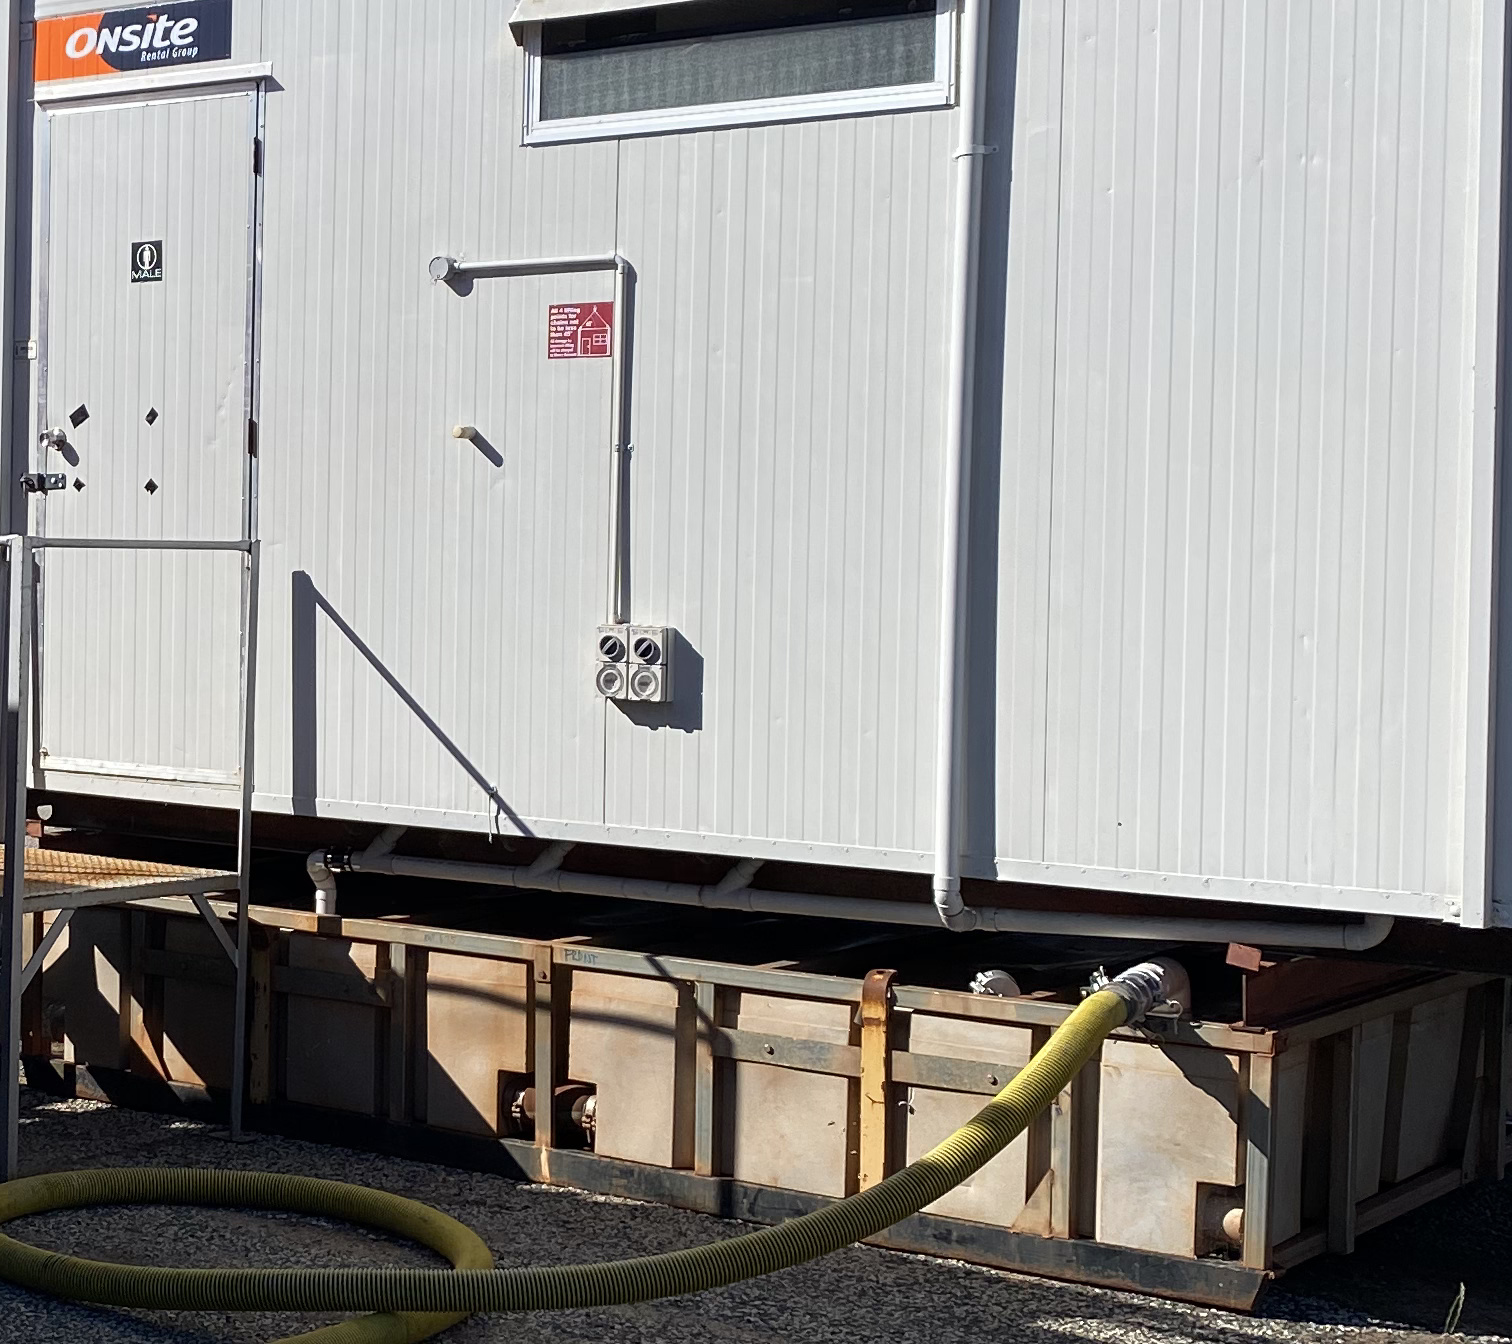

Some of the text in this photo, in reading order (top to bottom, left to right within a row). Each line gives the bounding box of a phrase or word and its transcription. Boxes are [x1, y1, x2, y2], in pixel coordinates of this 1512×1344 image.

[140, 46, 199, 62] Rental Group
[131, 268, 161, 279] MALE
